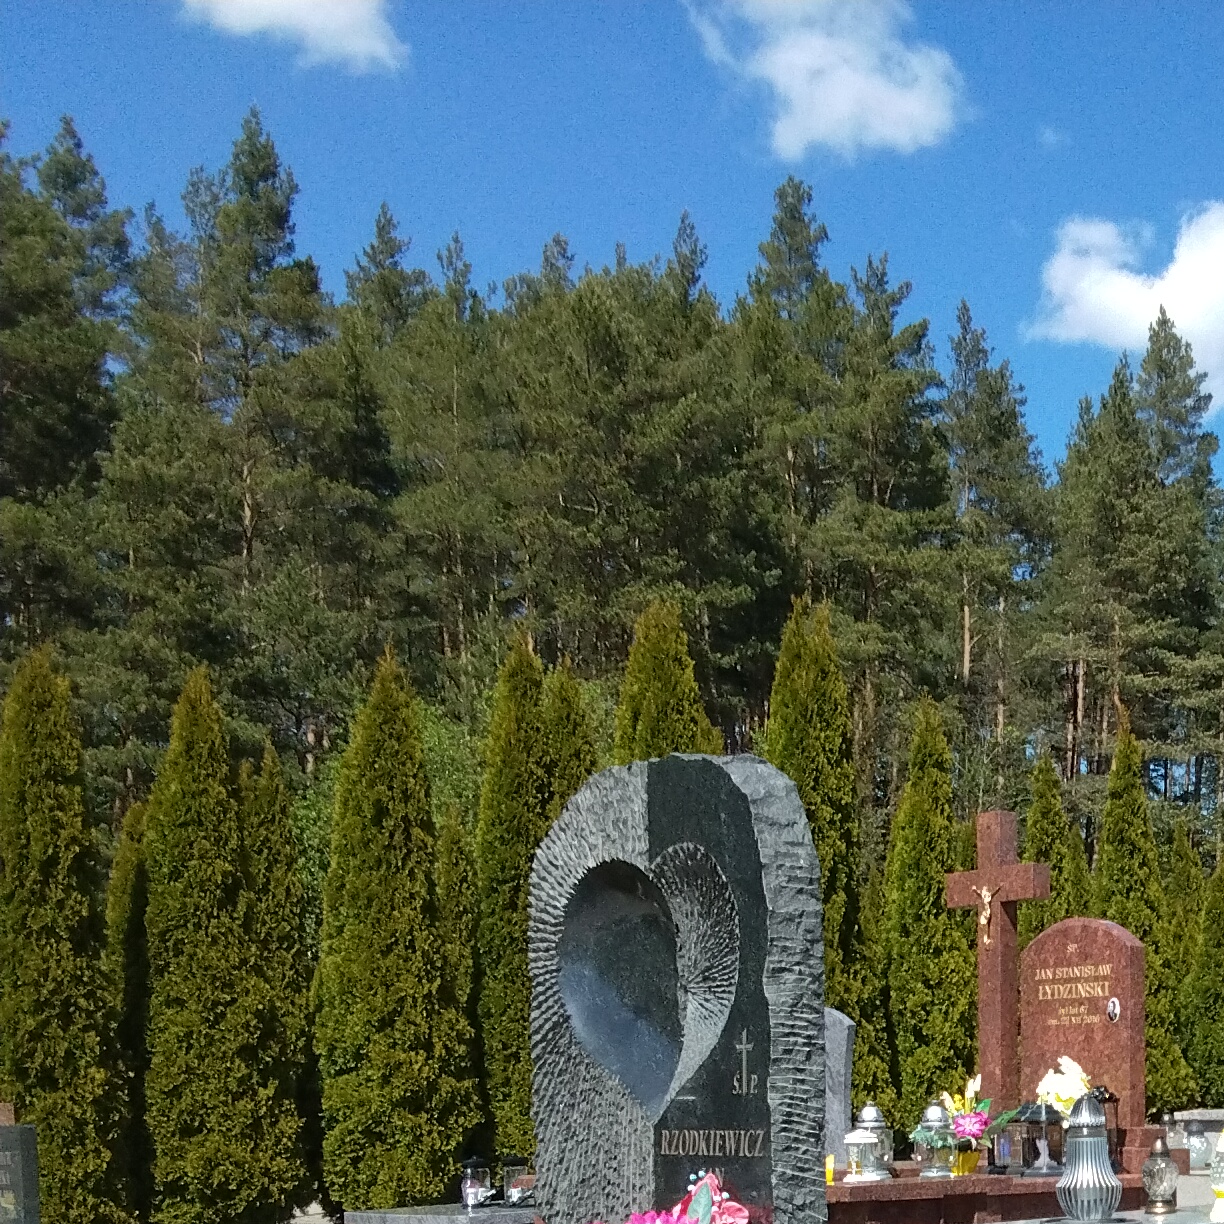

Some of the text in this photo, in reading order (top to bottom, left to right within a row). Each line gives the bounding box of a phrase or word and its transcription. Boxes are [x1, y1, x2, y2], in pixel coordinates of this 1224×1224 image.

[1035, 964, 1113, 981] JAN STANISŁAW
[1038, 980, 1110, 1000] ŁYDZIŃSKI
[660, 1129, 765, 1157] RZODKIEWICZ
